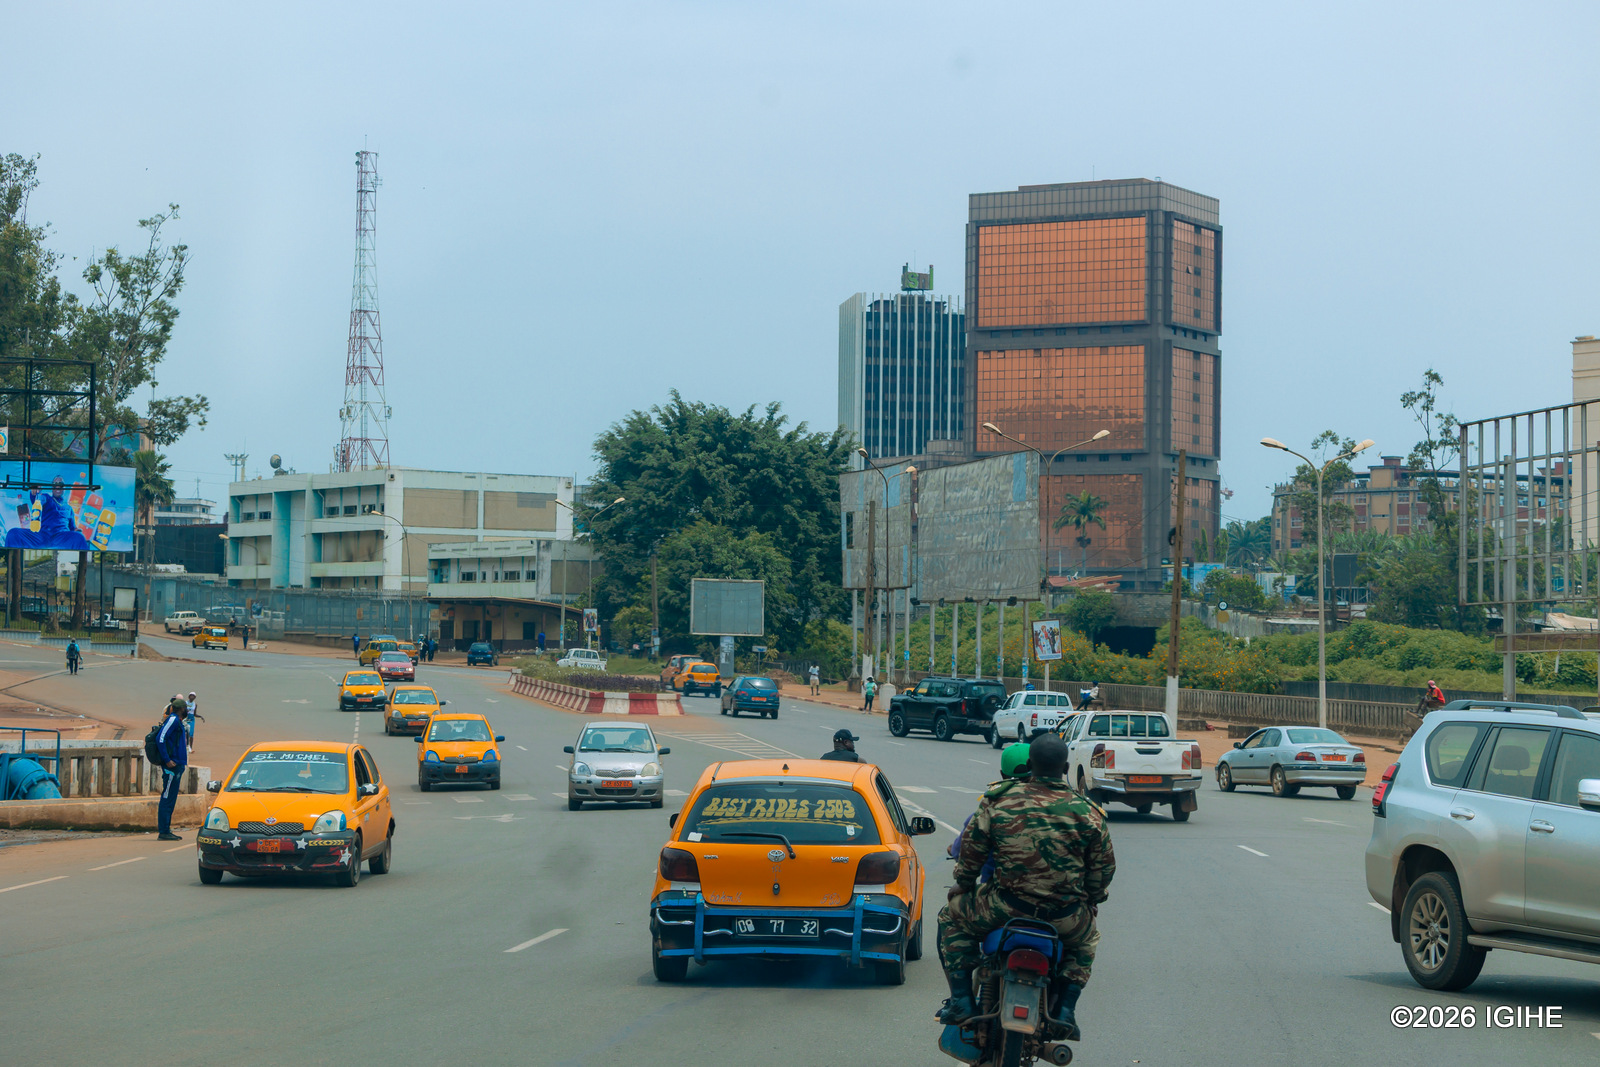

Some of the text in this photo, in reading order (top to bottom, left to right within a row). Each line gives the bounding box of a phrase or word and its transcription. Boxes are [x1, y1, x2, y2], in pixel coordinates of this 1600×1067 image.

[702, 797, 855, 818] BEST RIDES 2503
[770, 919, 785, 933] 77
[800, 920, 817, 934] 32
